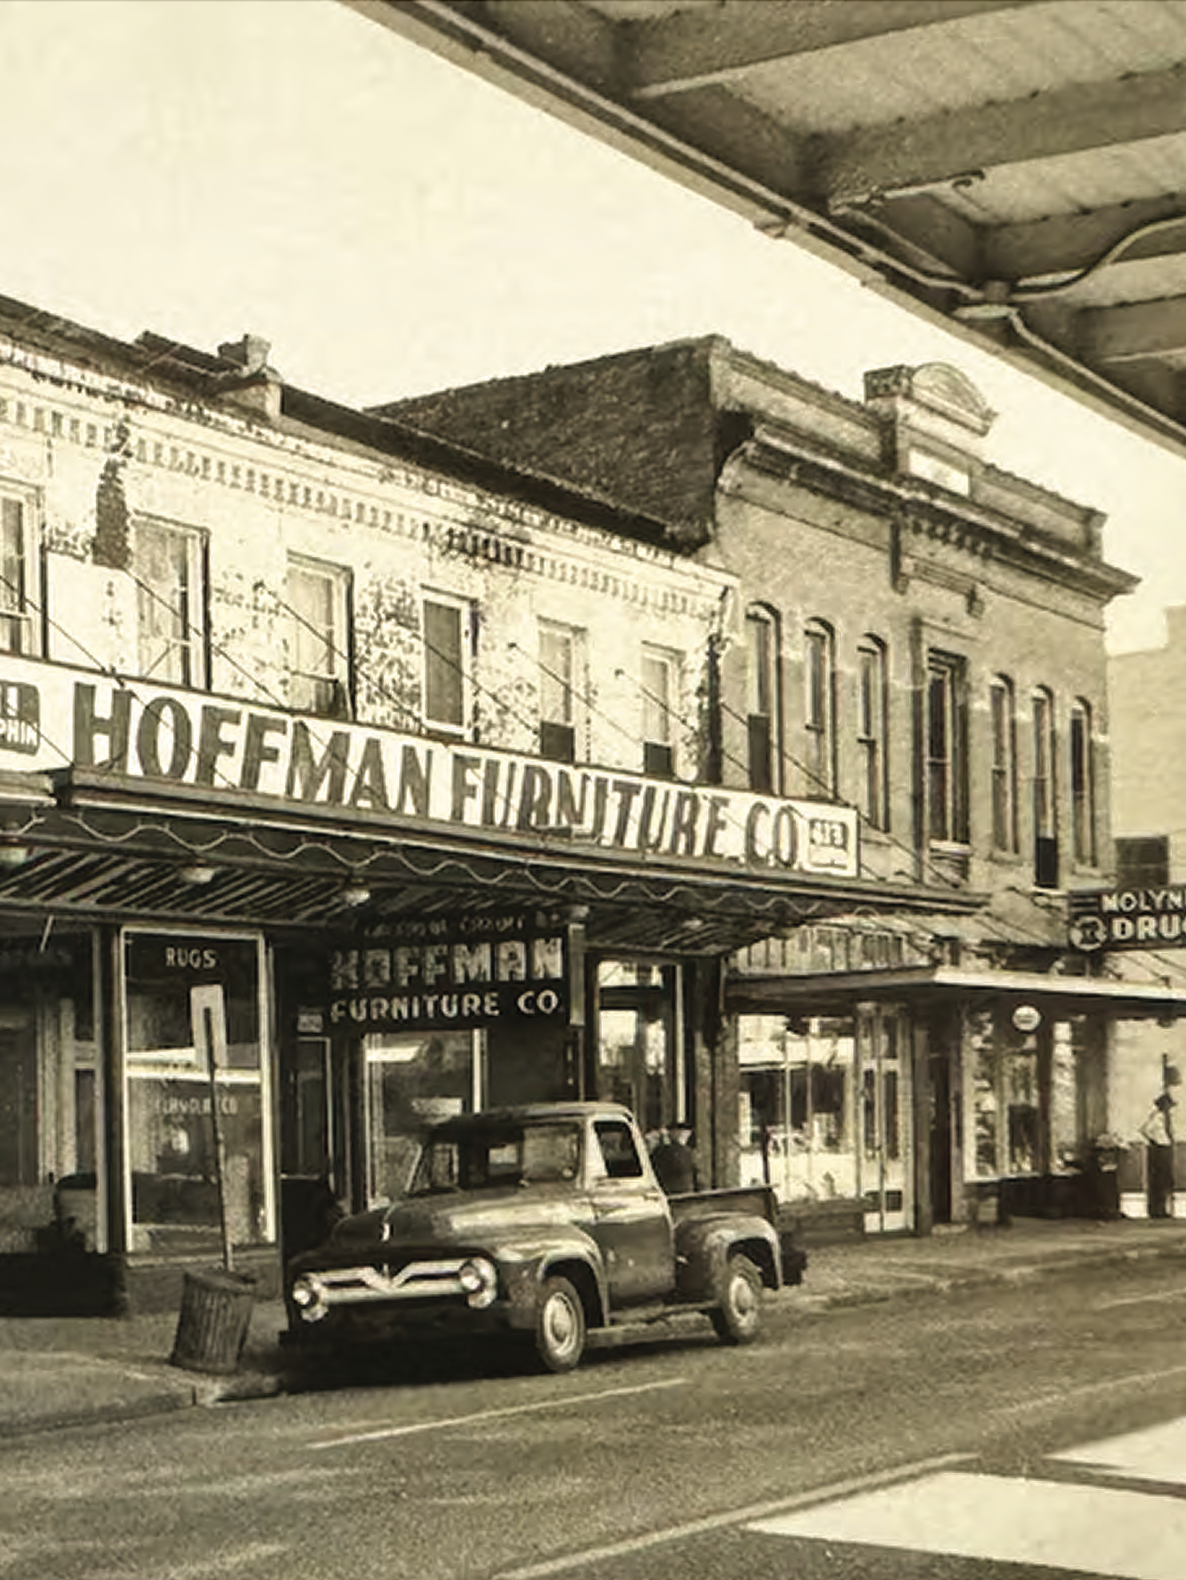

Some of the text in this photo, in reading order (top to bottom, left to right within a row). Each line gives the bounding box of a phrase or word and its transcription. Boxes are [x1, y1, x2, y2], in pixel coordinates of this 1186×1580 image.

[73, 680, 433, 820] HOFFMAN
[451, 753, 732, 857] FURNITURE
[1101, 888, 1186, 913] MOLYN
[1112, 914, 1186, 940] DRU
[166, 946, 217, 969] RUGS
[330, 938, 564, 990] HOFFMAN
[330, 992, 501, 1024] FURNITURE
